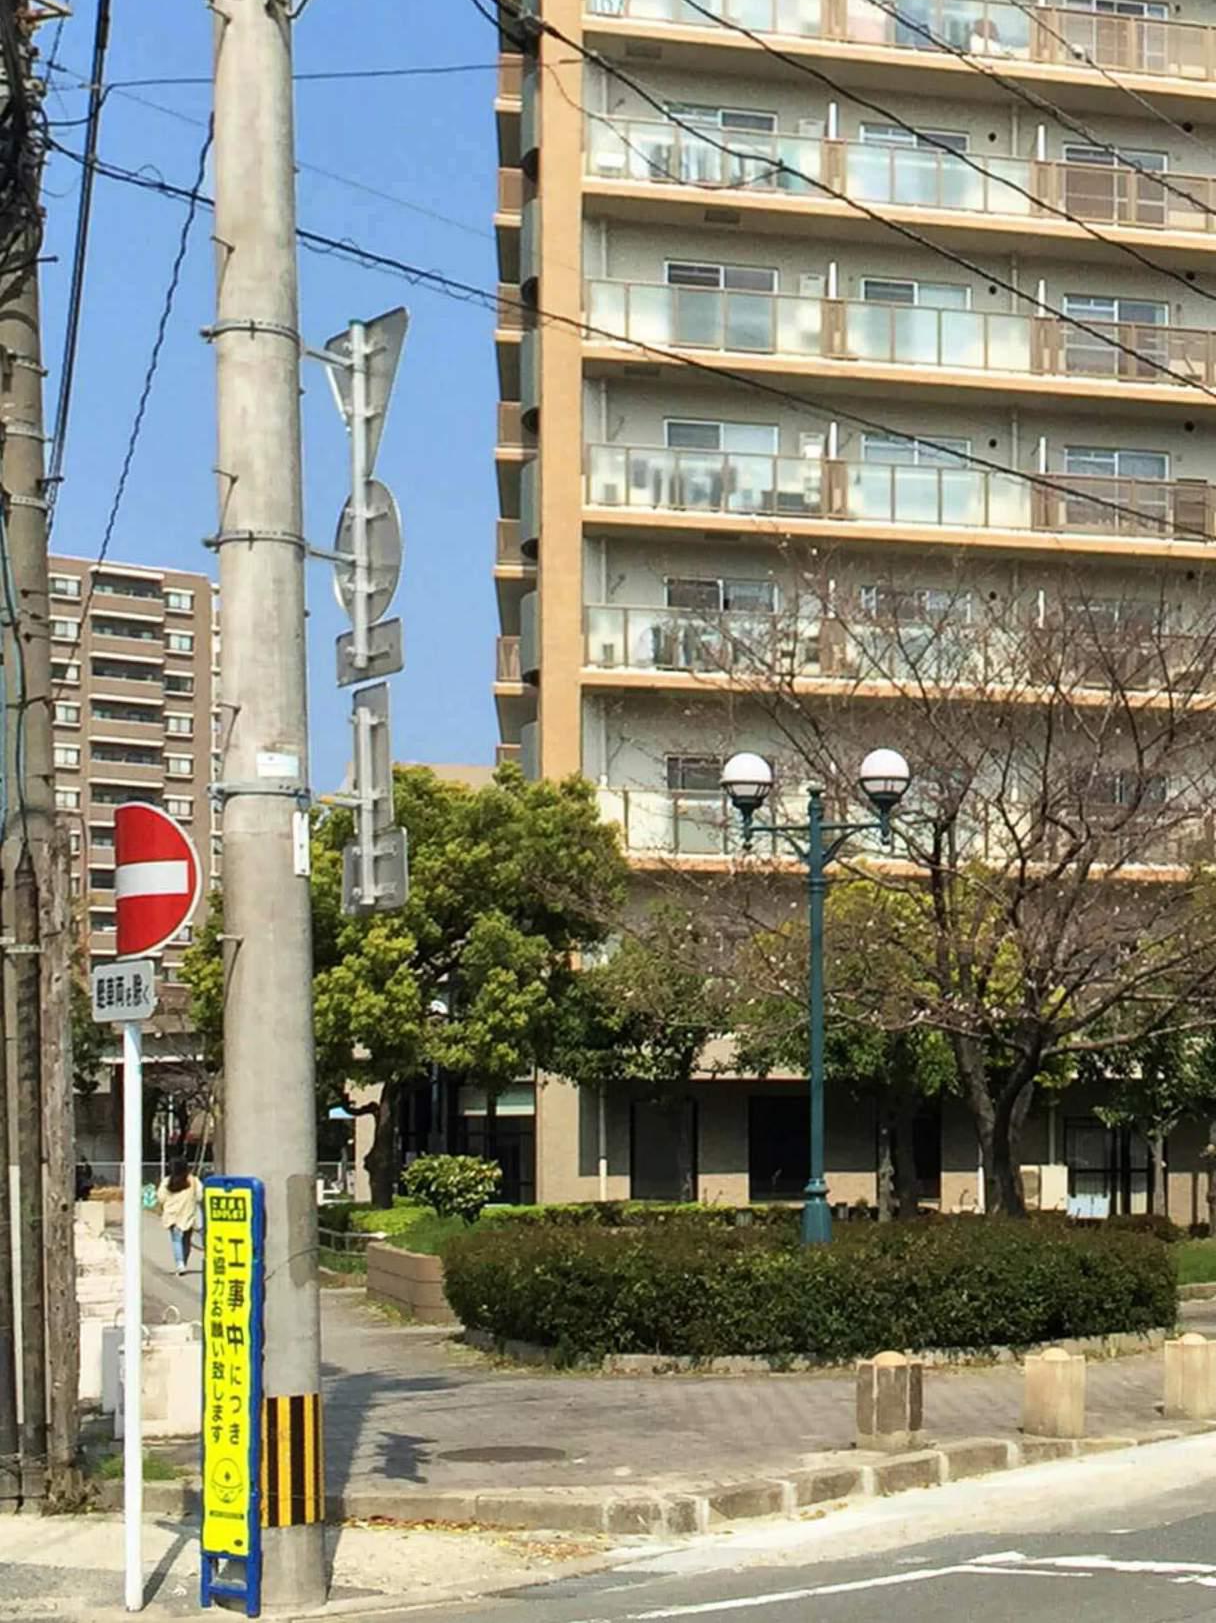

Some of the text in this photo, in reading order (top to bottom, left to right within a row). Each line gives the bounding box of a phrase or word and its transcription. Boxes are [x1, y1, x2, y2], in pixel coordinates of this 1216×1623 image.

[211, 1235, 226, 1444] ご協力お願い致します
[227, 1238, 246, 1445] 工事中につき
